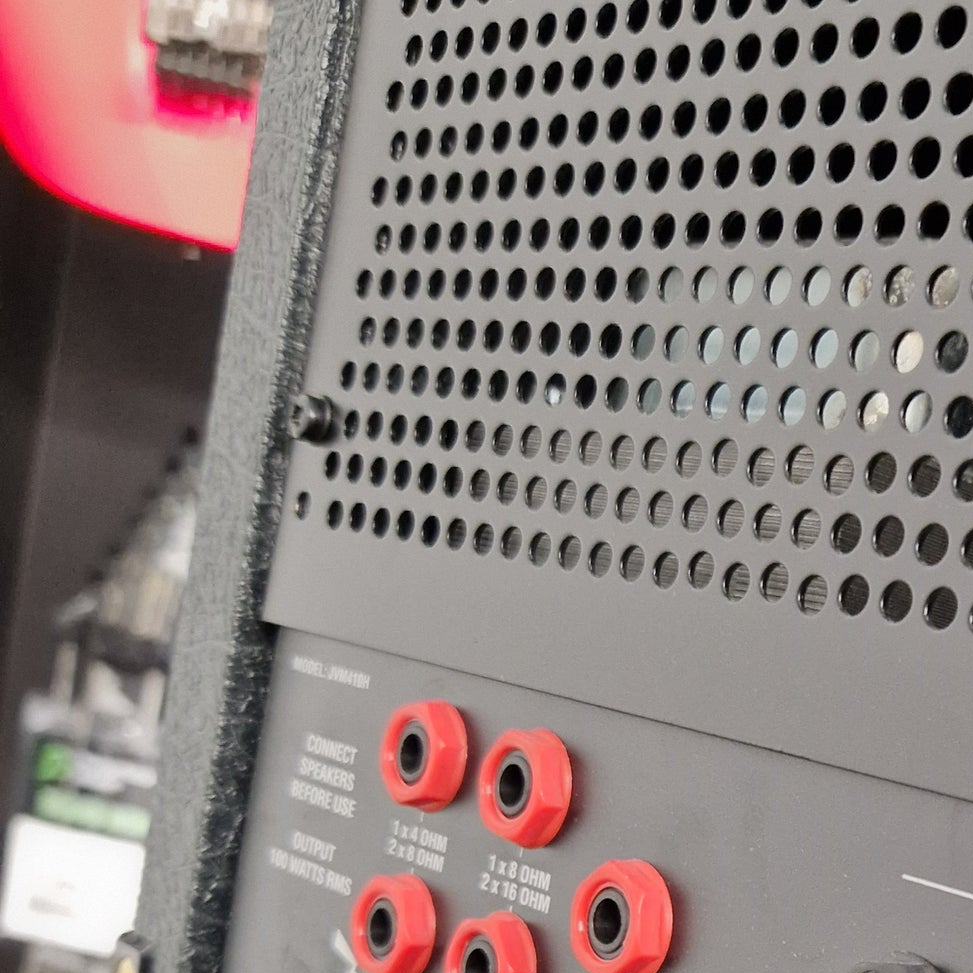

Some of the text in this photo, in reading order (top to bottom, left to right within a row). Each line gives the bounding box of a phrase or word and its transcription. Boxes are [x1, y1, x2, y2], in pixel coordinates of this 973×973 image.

[306, 734, 358, 765] CONNECT
[300, 756, 355, 791] SPEAKERS
[290, 779, 357, 818] BEFORE USE
[293, 831, 337, 862] OUTPUT
[387, 838, 397, 855] 2
[407, 844, 416, 862] 8
[416, 849, 445, 873] OHM
[410, 826, 419, 842] 4
[420, 829, 448, 853] OHM
[270, 848, 352, 896] 100 WATTS RMS
[489, 853, 498, 872] 1
[508, 860, 518, 880] 8
[520, 864, 552, 892] OHM
[481, 872, 491, 891] 2
[502, 880, 518, 901] 16
[520, 886, 551, 914] OHM
